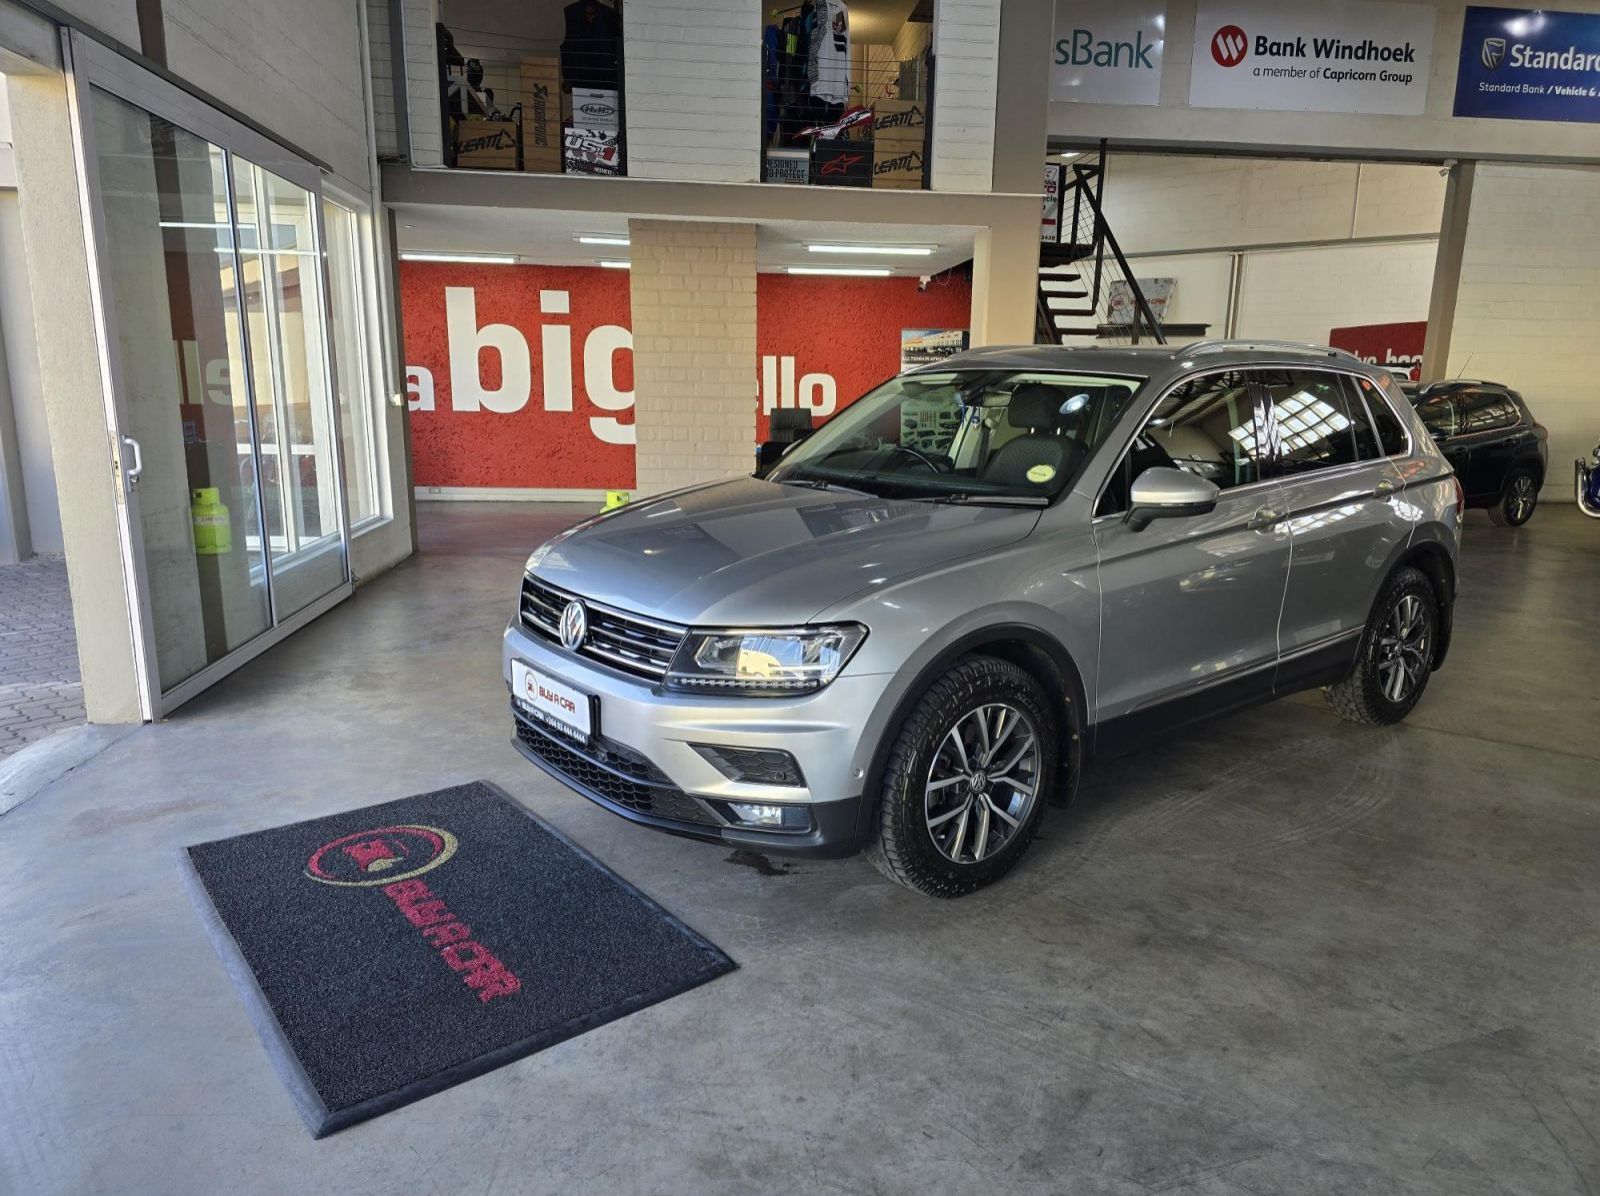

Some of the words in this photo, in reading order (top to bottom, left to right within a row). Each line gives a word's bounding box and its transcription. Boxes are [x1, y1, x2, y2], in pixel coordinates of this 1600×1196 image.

[1254, 35, 1307, 58] Bank
[1313, 38, 1415, 63] Windhoek
[1253, 67, 1260, 76] a
[1263, 66, 1306, 79] member
[1310, 66, 1320, 79] of
[1323, 68, 1376, 83] Capricorn
[1380, 70, 1413, 85] Group
[1479, 81, 1521, 93] Standard
[1522, 84, 1545, 94] Bank
[1555, 86, 1587, 96] Vehicle
[405, 365, 436, 411] a
[445, 286, 636, 445] big
[757, 355, 837, 416] llo
